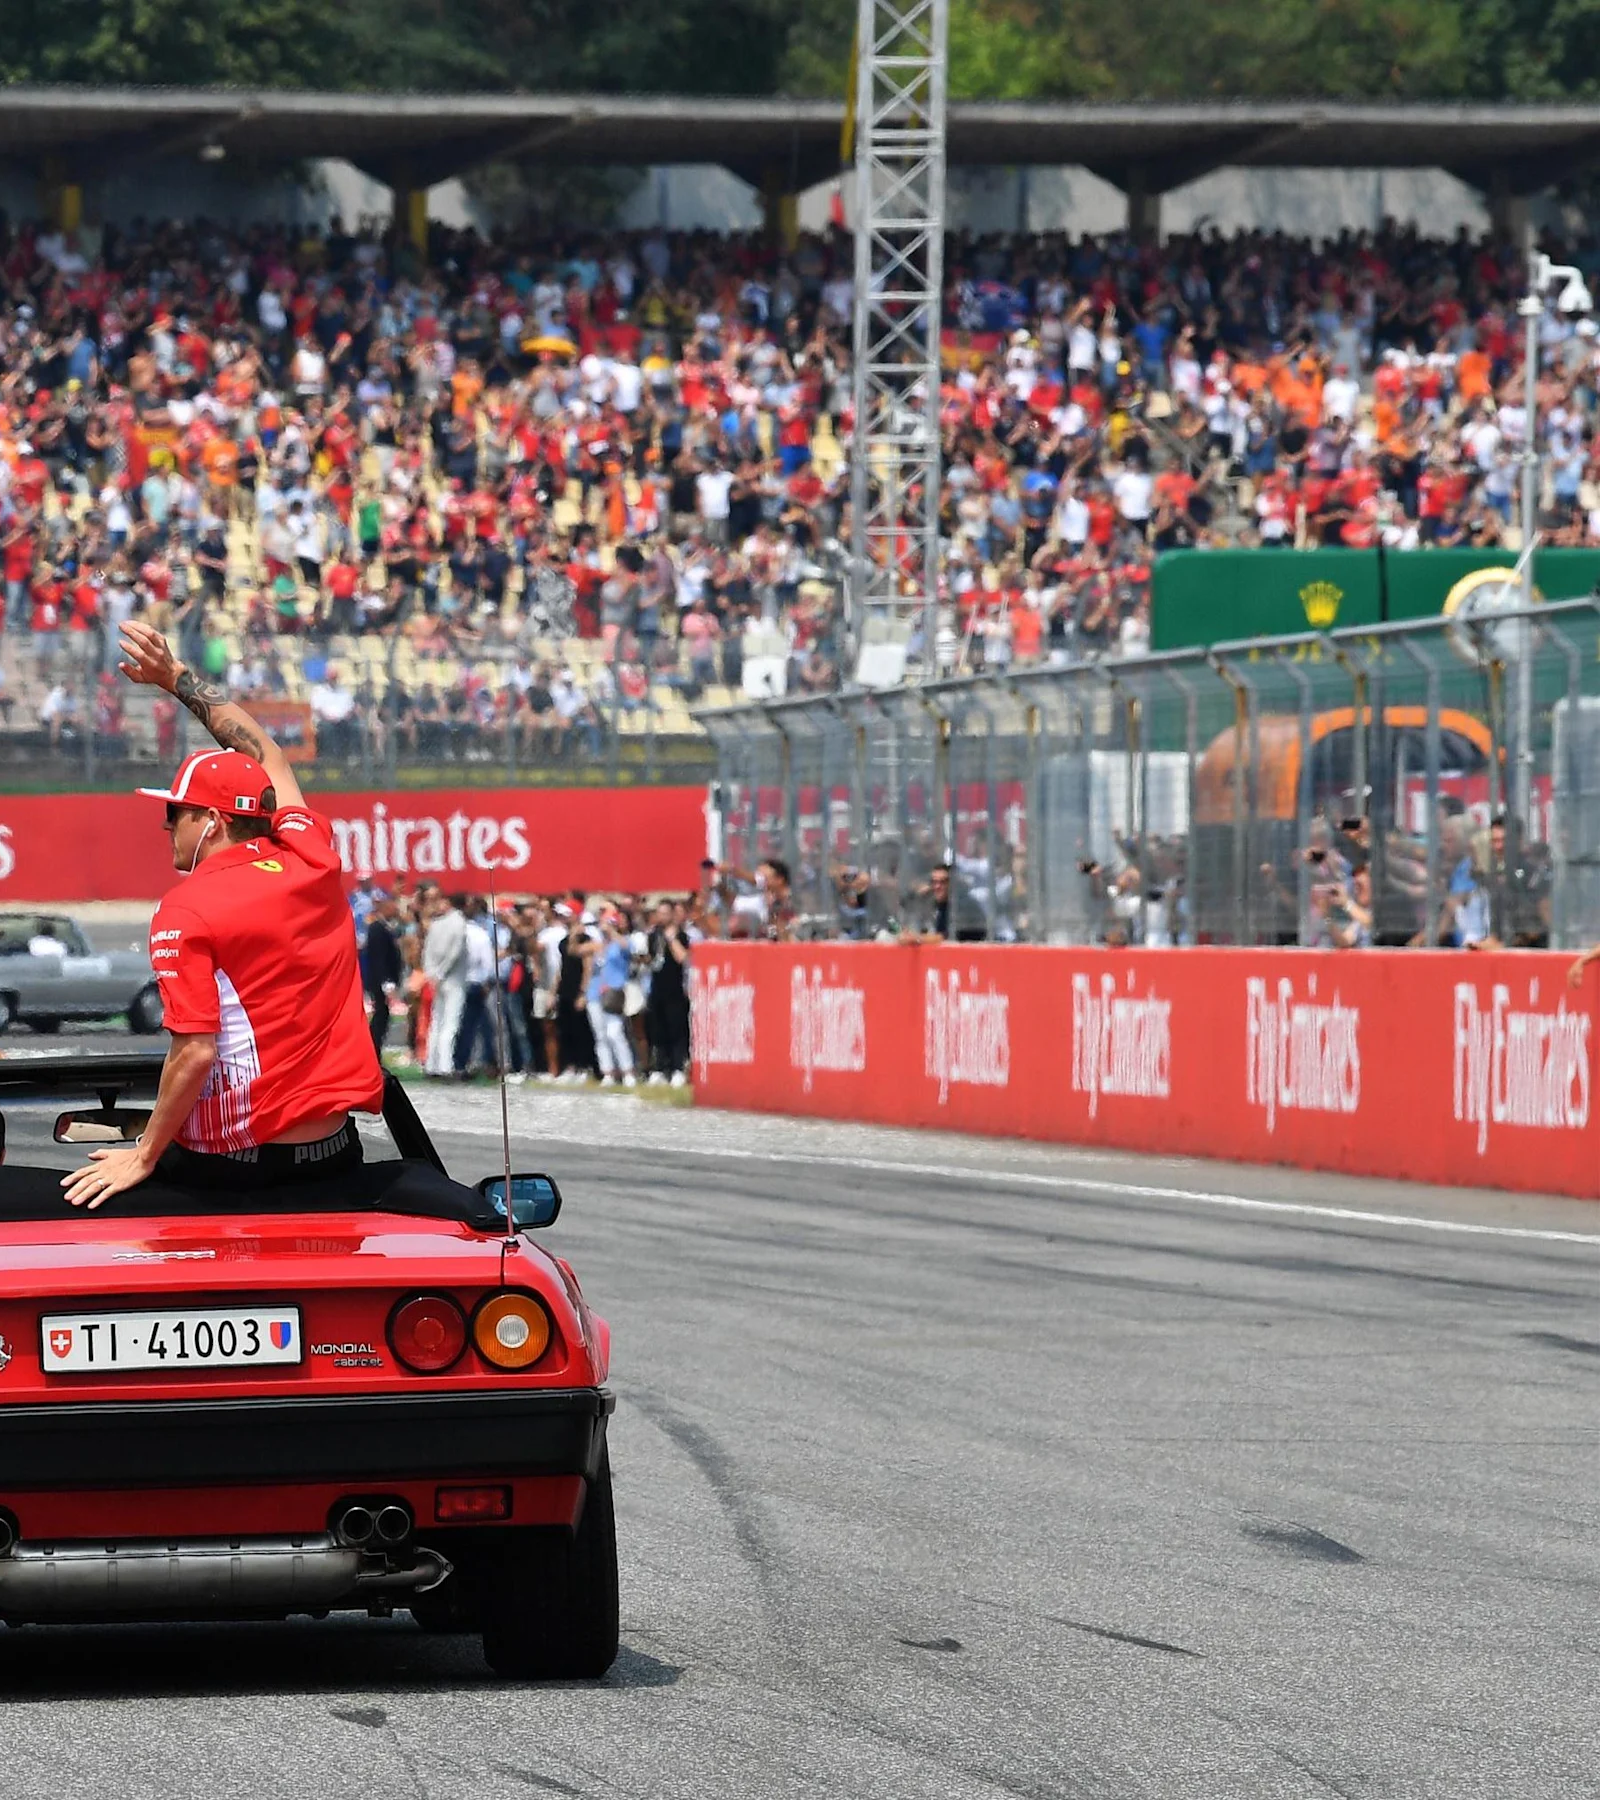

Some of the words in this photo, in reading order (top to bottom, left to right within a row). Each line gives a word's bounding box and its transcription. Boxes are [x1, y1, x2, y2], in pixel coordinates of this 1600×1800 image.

[330, 801, 532, 873] mirates
[295, 1128, 349, 1164] PUMA
[80, 1323, 118, 1362] TI
[147, 1319, 261, 1360] 41003
[310, 1343, 377, 1355] MONDIAL
